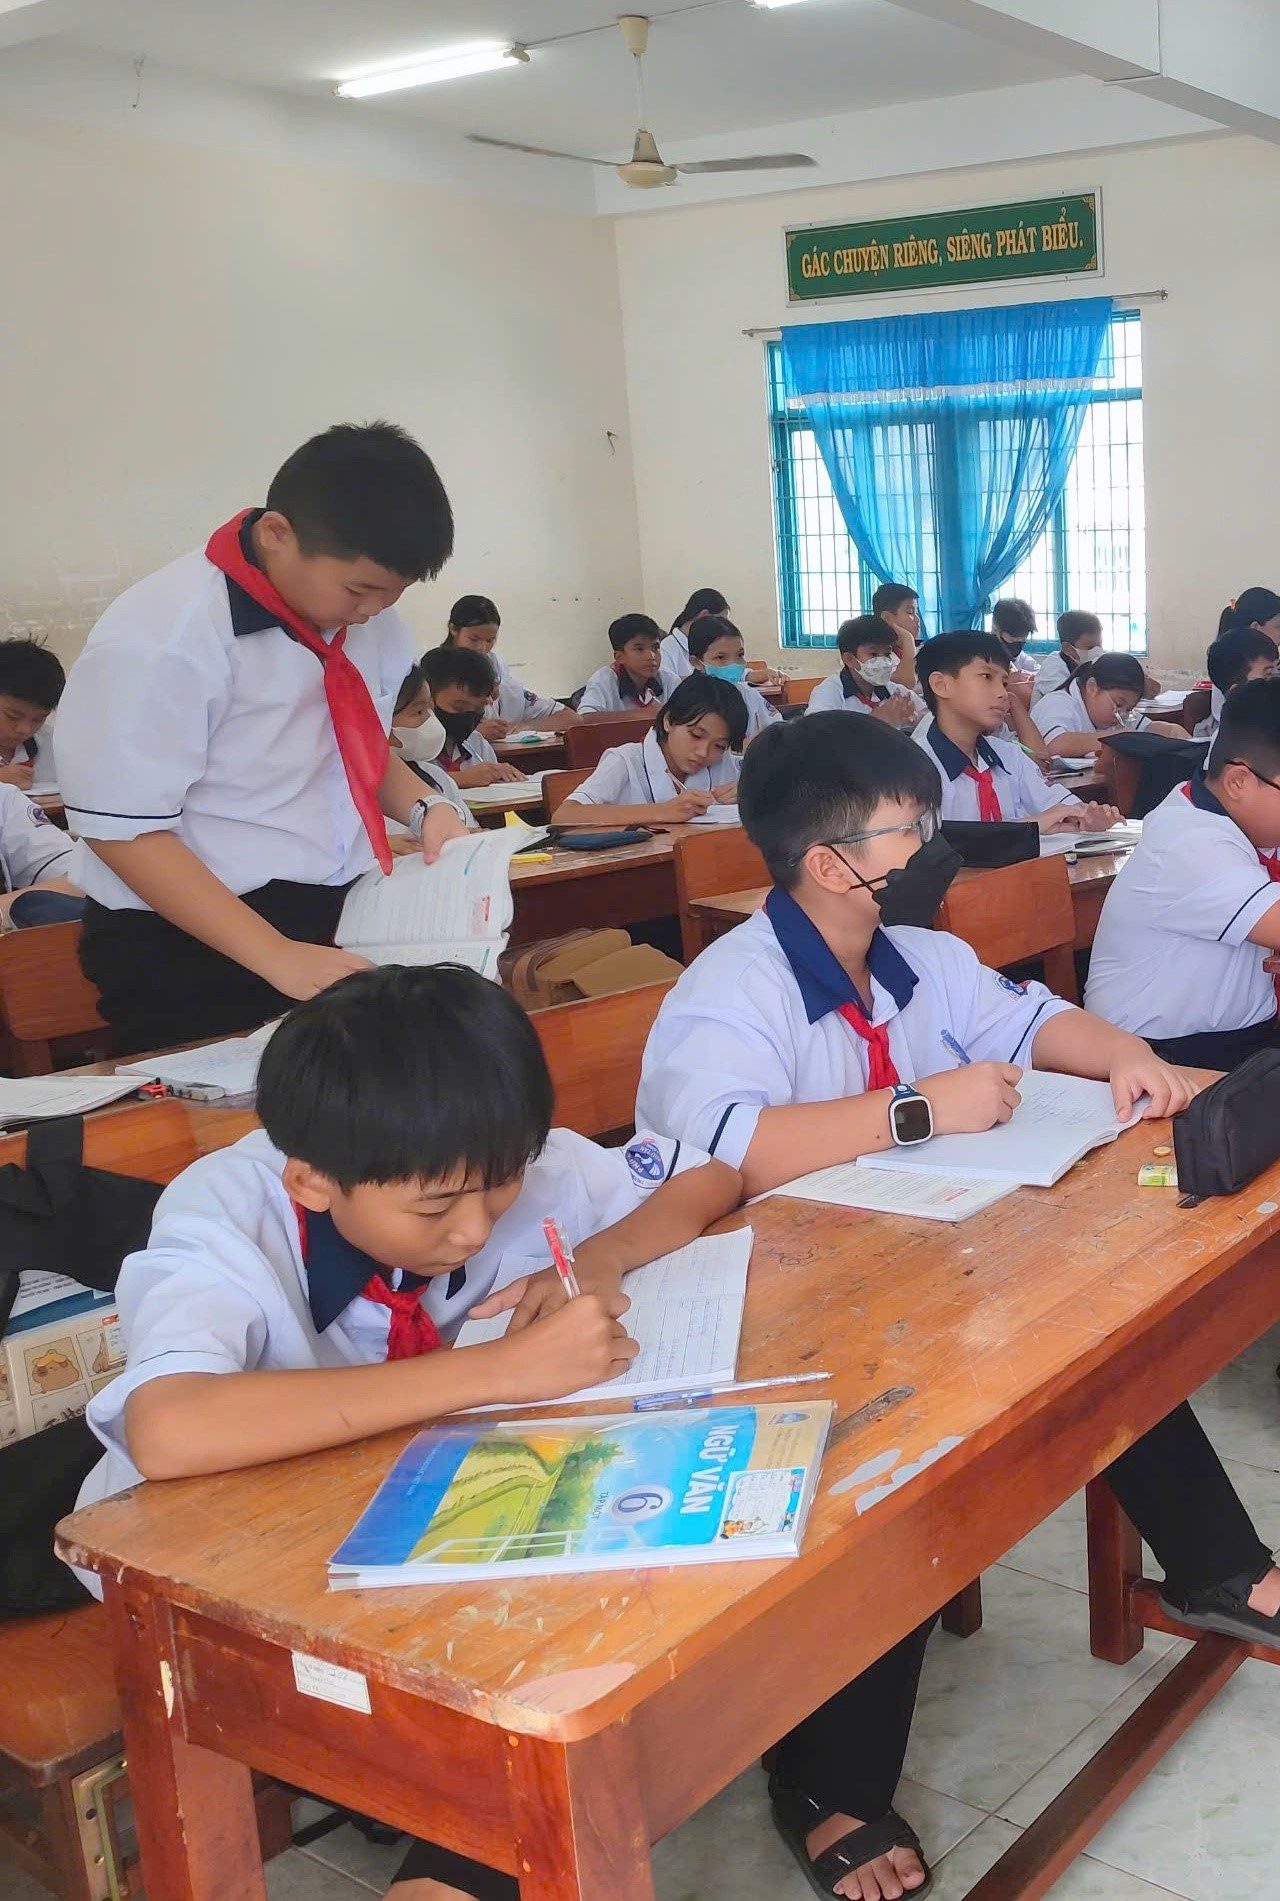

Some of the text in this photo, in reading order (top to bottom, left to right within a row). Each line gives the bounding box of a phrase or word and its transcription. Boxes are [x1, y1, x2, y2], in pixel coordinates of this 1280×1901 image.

[801, 206, 1085, 278] GÁC CHUYỆN RIÊNG, SIÊNG PHÁT BIỂU.
[617, 1492, 664, 1513] 6
[679, 1424, 740, 1514] NGỮ VĂN
